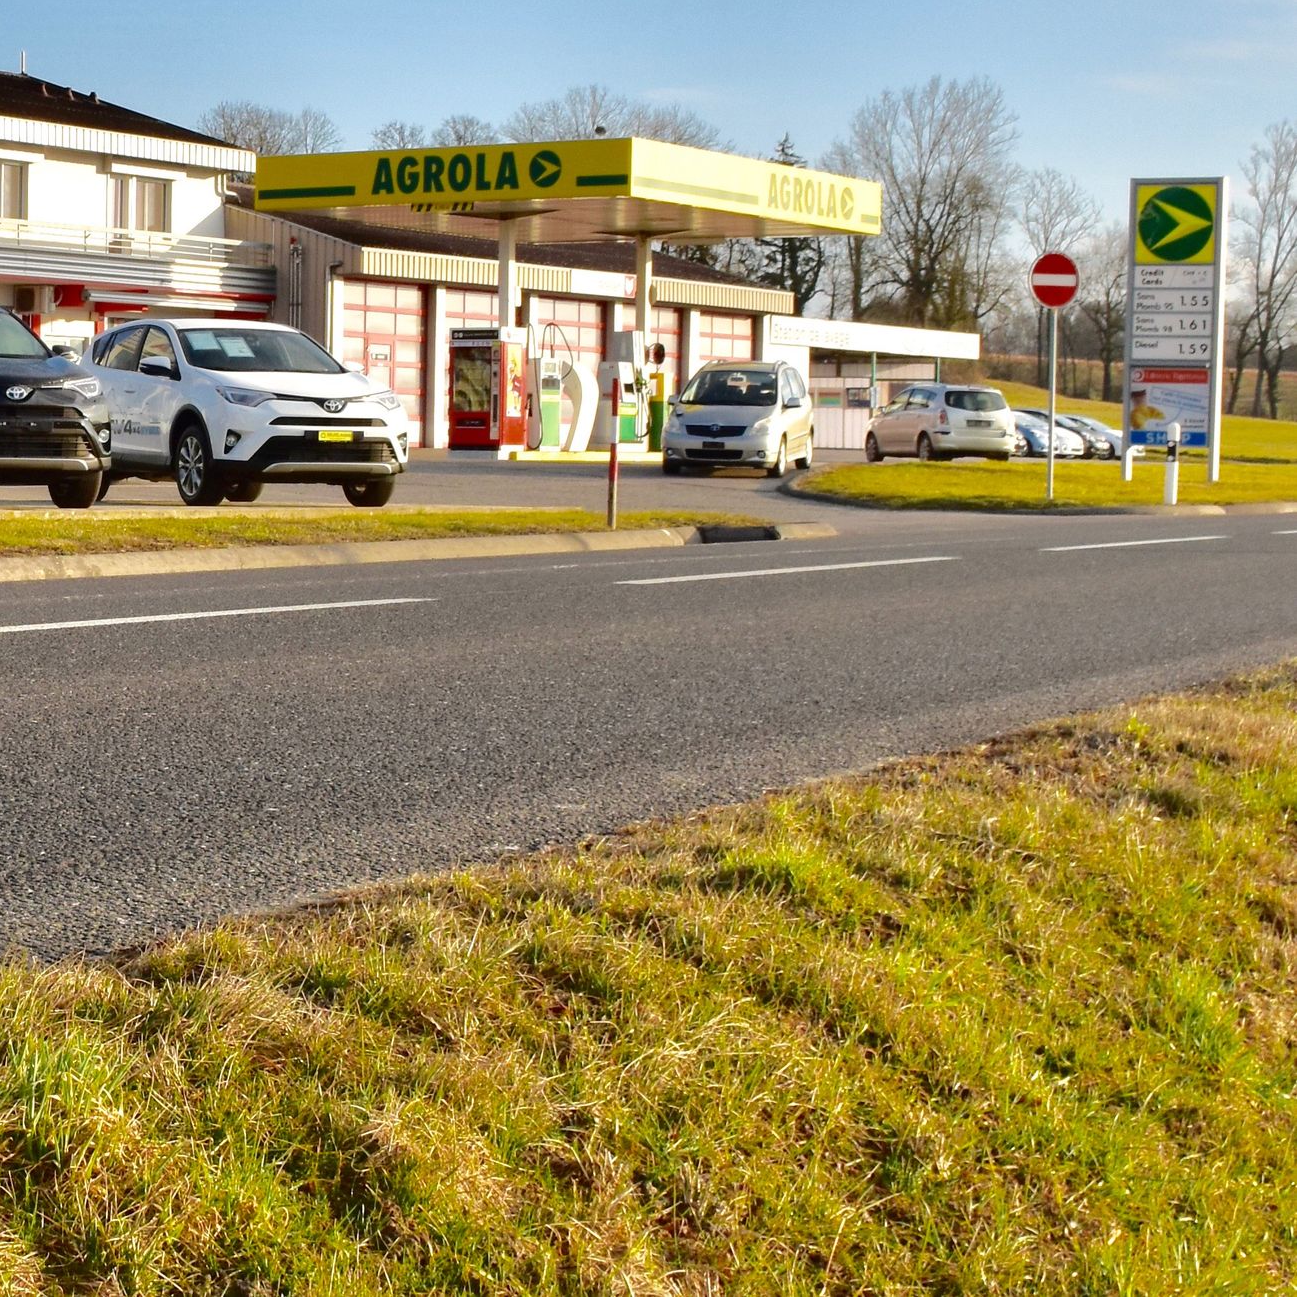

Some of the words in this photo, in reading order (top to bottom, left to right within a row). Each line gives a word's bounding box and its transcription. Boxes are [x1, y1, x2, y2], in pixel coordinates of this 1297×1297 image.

[371, 151, 519, 196] AGROLA
[767, 173, 838, 219] AGROLA
[1140, 269, 1164, 277] Credit
[1134, 341, 1159, 349] Diesel
[1145, 433, 1191, 446] SHP
